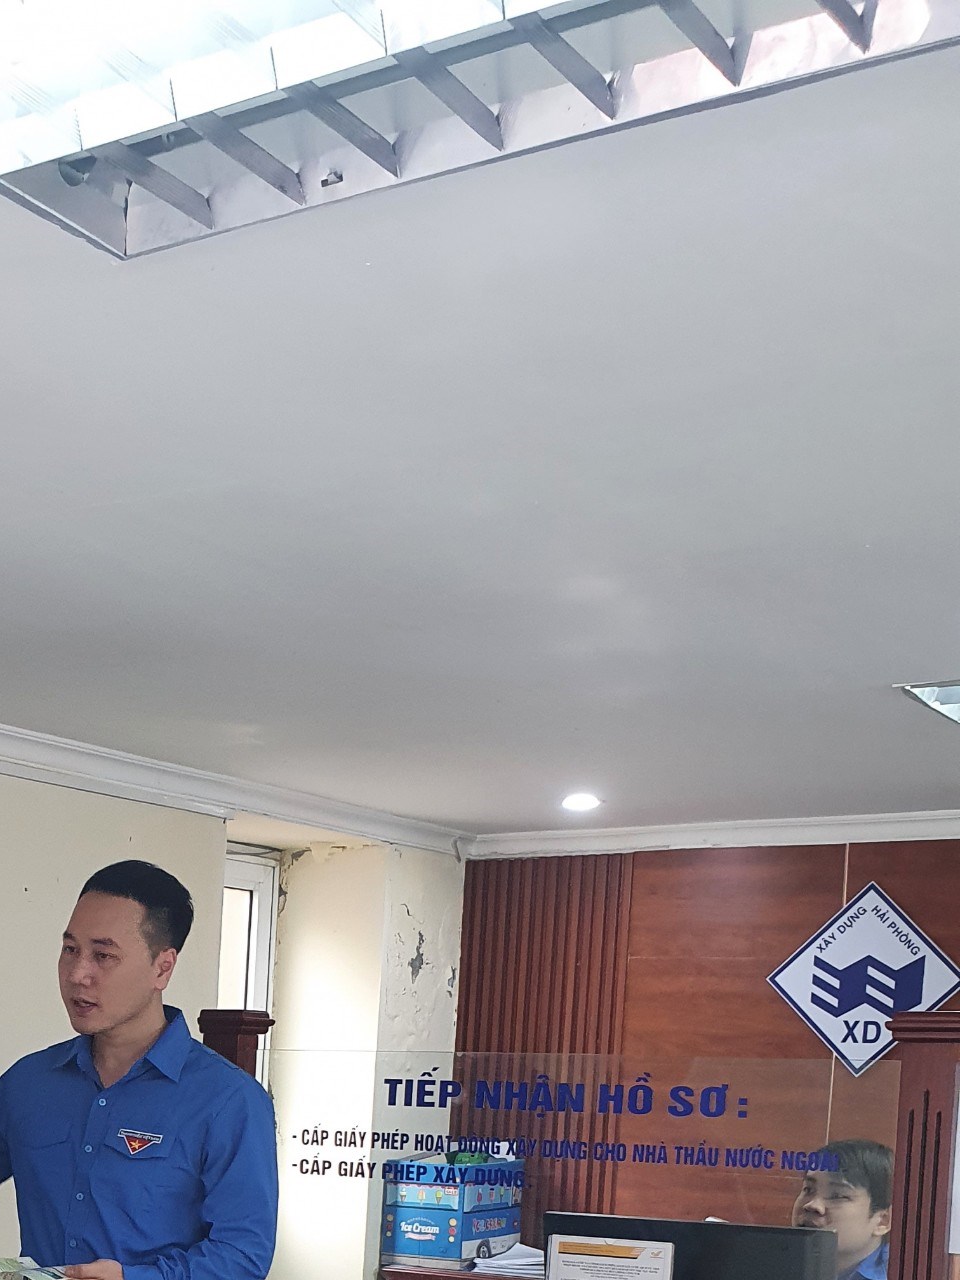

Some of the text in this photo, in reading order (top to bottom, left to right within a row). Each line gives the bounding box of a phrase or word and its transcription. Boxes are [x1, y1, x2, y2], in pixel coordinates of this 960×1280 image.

[816, 905, 921, 956] XÂY DỰNG HẢI PHÒNG
[841, 1020, 882, 1044] XD
[384, 1067, 462, 1108] TIẾP
[475, 1073, 585, 1119] NHẬN
[598, 1072, 653, 1116] HỒ
[302, 1123, 329, 1147] CẤP
[334, 1125, 366, 1149] GIẤY
[371, 1128, 409, 1151] PHÉP
[414, 1133, 452, 1155] HOẠT
[458, 1131, 501, 1158] ĐỘNG
[507, 1134, 537, 1157] XÂY
[541, 1138, 588, 1162] DỰNG
[593, 1141, 627, 1162] CHO
[632, 1140, 668, 1164] NHÀ
[675, 1140, 719, 1167] THẦU
[725, 1143, 775, 1170] NƯỚC
[780, 1148, 839, 1173] NGOÀI
[338, 1155, 376, 1180] GIẤY
[382, 1159, 428, 1182] PHÉP
[433, 1162, 468, 1186] XÂY
[400, 1221, 413, 1232] Ice
[413, 1221, 440, 1234] Cream
